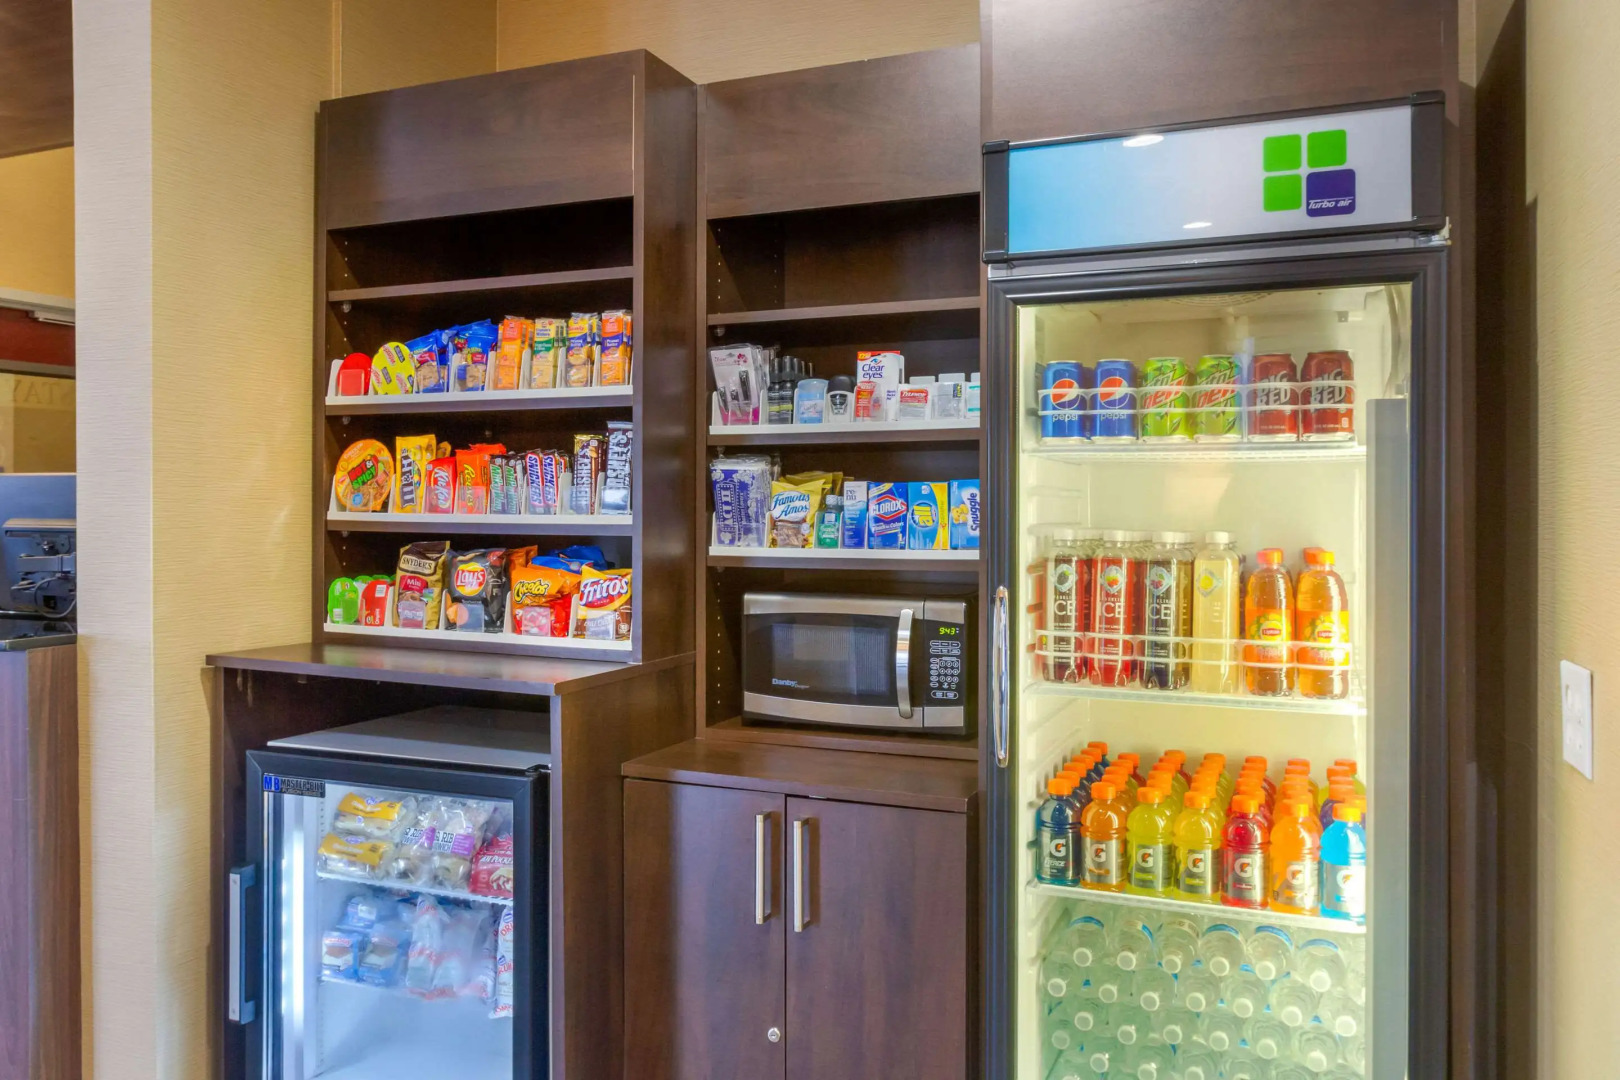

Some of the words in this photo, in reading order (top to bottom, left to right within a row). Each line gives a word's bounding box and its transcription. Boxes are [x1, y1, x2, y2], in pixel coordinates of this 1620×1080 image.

[1308, 199, 1336, 209] Turbo
[1337, 199, 1353, 207] air
[862, 363, 885, 372] Clear
[863, 372, 883, 380] eyes
[1259, 371, 1288, 394] BIG
[1312, 369, 1342, 392] BIG
[1257, 387, 1291, 413] RED
[1311, 385, 1346, 412] RED
[1053, 414, 1078, 422] pepsi
[1101, 412, 1126, 421] pepsi
[349, 460, 368, 481] HOT
[367, 460, 374, 468] &
[353, 465, 377, 490] SPICY
[528, 455, 542, 504] SNICKERS
[543, 455, 556, 504] SNICKERS
[769, 493, 810, 511] Famous
[775, 504, 809, 519] Amos
[872, 500, 902, 515] CLOROX
[967, 492, 980, 531] Snuggle
[914, 505, 934, 527] all
[402, 556, 433, 570] SNYDER'S
[457, 570, 485, 589] Lay's
[514, 579, 549, 603] Cheetos
[580, 577, 628, 606] Fritos
[1054, 600, 1078, 616] CE
[1149, 603, 1173, 620] CE
[772, 678, 798, 688] Danby
[441, 832, 455, 843] RIB
[1049, 838, 1066, 857] G
[1091, 843, 1106, 862] G
[1136, 848, 1153, 867] G
[1187, 853, 1205, 873] G
[1234, 858, 1253, 878] G
[1286, 865, 1305, 884] G
